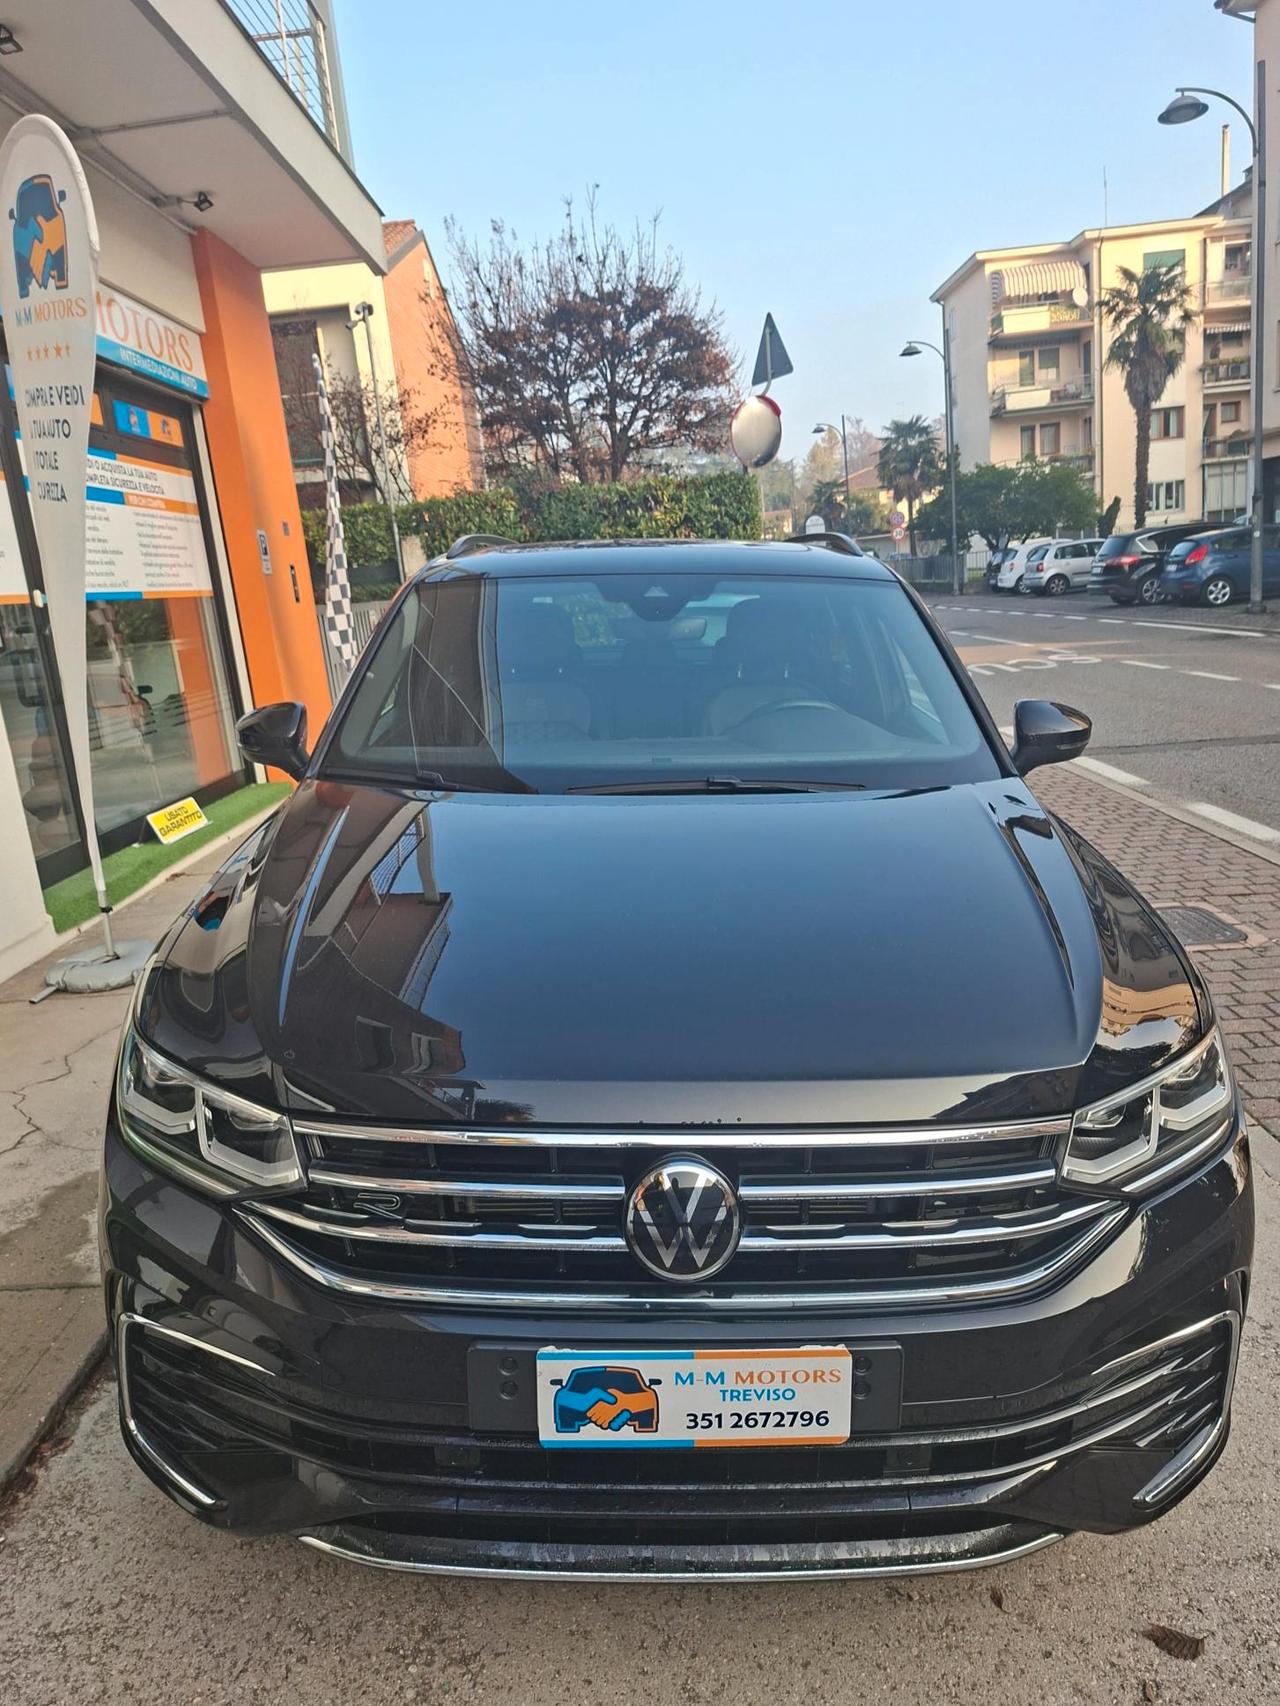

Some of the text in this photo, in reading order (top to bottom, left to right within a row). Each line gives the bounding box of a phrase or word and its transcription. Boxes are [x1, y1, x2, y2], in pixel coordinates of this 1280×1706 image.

[34, 297, 87, 321] MOTORS
[967, 654, 1102, 676] SCU
[159, 810, 203, 837] GARANTITO
[164, 806, 189, 822] USATO
[674, 1368, 842, 1386] M-M MOTORS
[719, 1388, 797, 1402] TREVISO
[686, 1410, 830, 1430] 351 2672796
